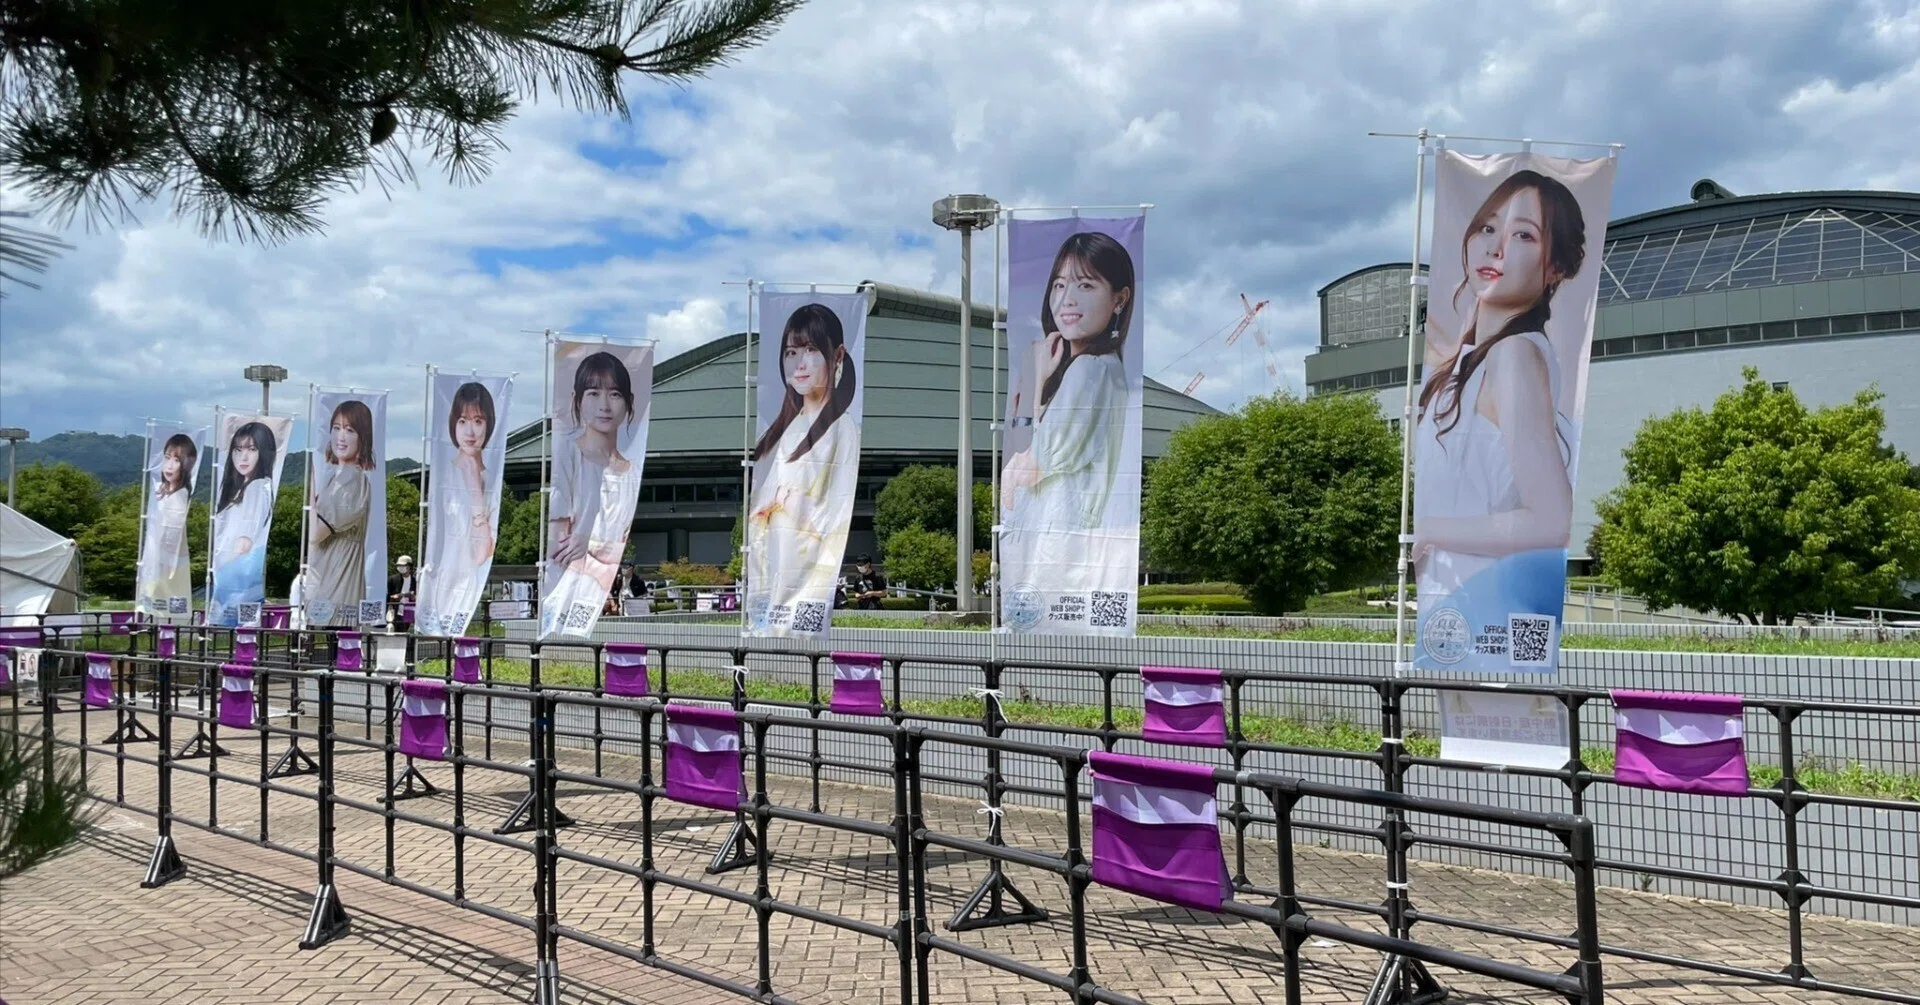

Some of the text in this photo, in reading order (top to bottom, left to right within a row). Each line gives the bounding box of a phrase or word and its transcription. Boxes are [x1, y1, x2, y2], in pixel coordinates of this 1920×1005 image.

[1060, 596, 1086, 604] OFFICIAL
[1050, 604, 1063, 612] WEB
[1475, 635, 1489, 644] WEB
